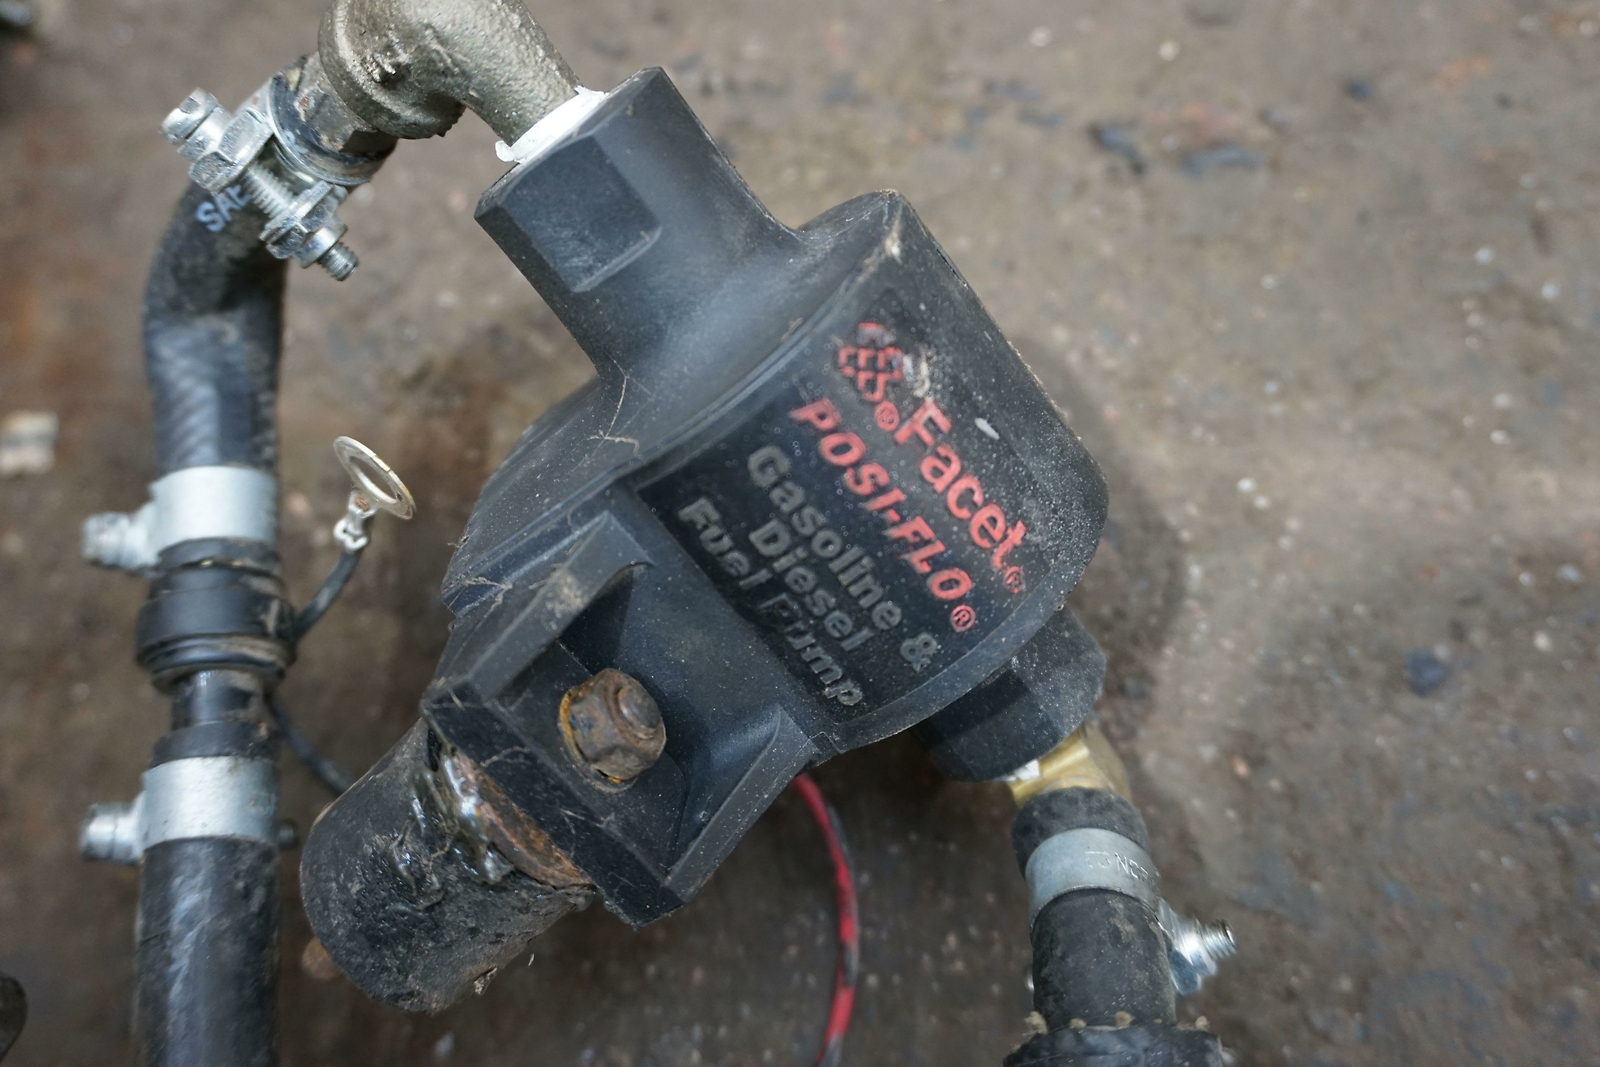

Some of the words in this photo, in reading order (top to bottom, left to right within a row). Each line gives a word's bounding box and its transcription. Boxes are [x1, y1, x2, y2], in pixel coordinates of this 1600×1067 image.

[747, 445, 901, 630] Gasoline
[901, 633, 938, 672] &
[748, 519, 874, 651] Diesel
[789, 398, 973, 600] POSI-FLO
[895, 400, 1027, 569] Facet
[678, 497, 772, 588] Fuel
[757, 592, 863, 706] Pump
